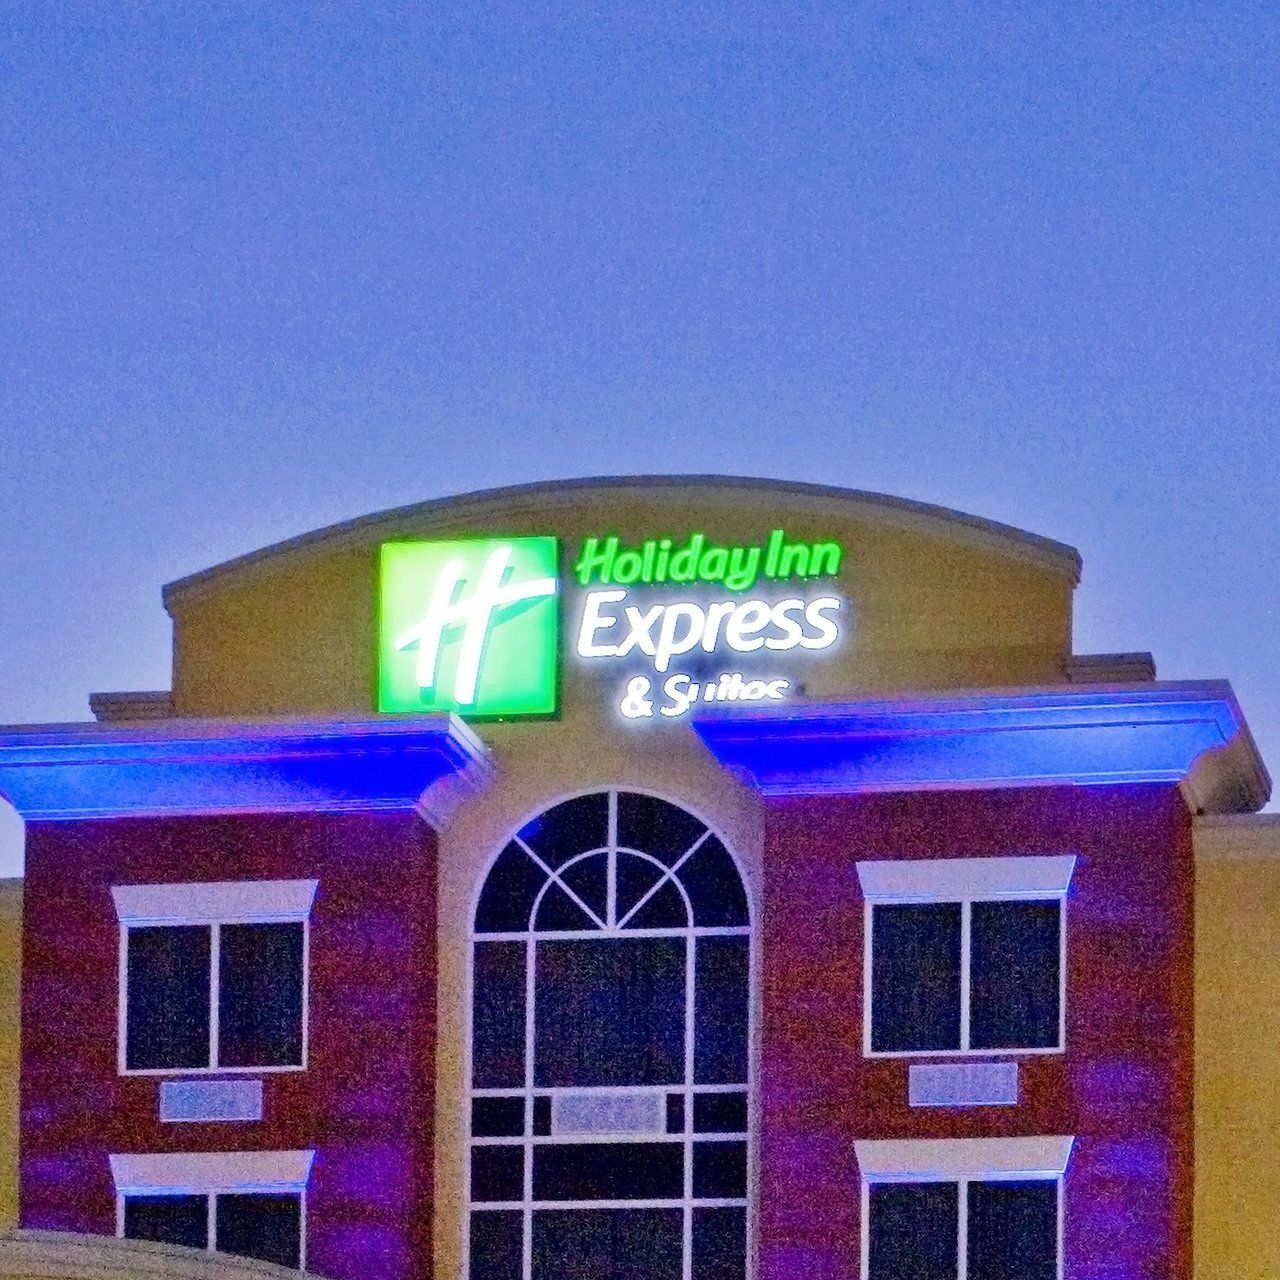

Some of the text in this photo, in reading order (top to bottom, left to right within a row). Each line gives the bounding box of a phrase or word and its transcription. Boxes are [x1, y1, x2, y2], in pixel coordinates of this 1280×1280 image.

[576, 529, 842, 590] Holiday Inn
[577, 590, 841, 672] Express
[620, 676, 654, 718] &
